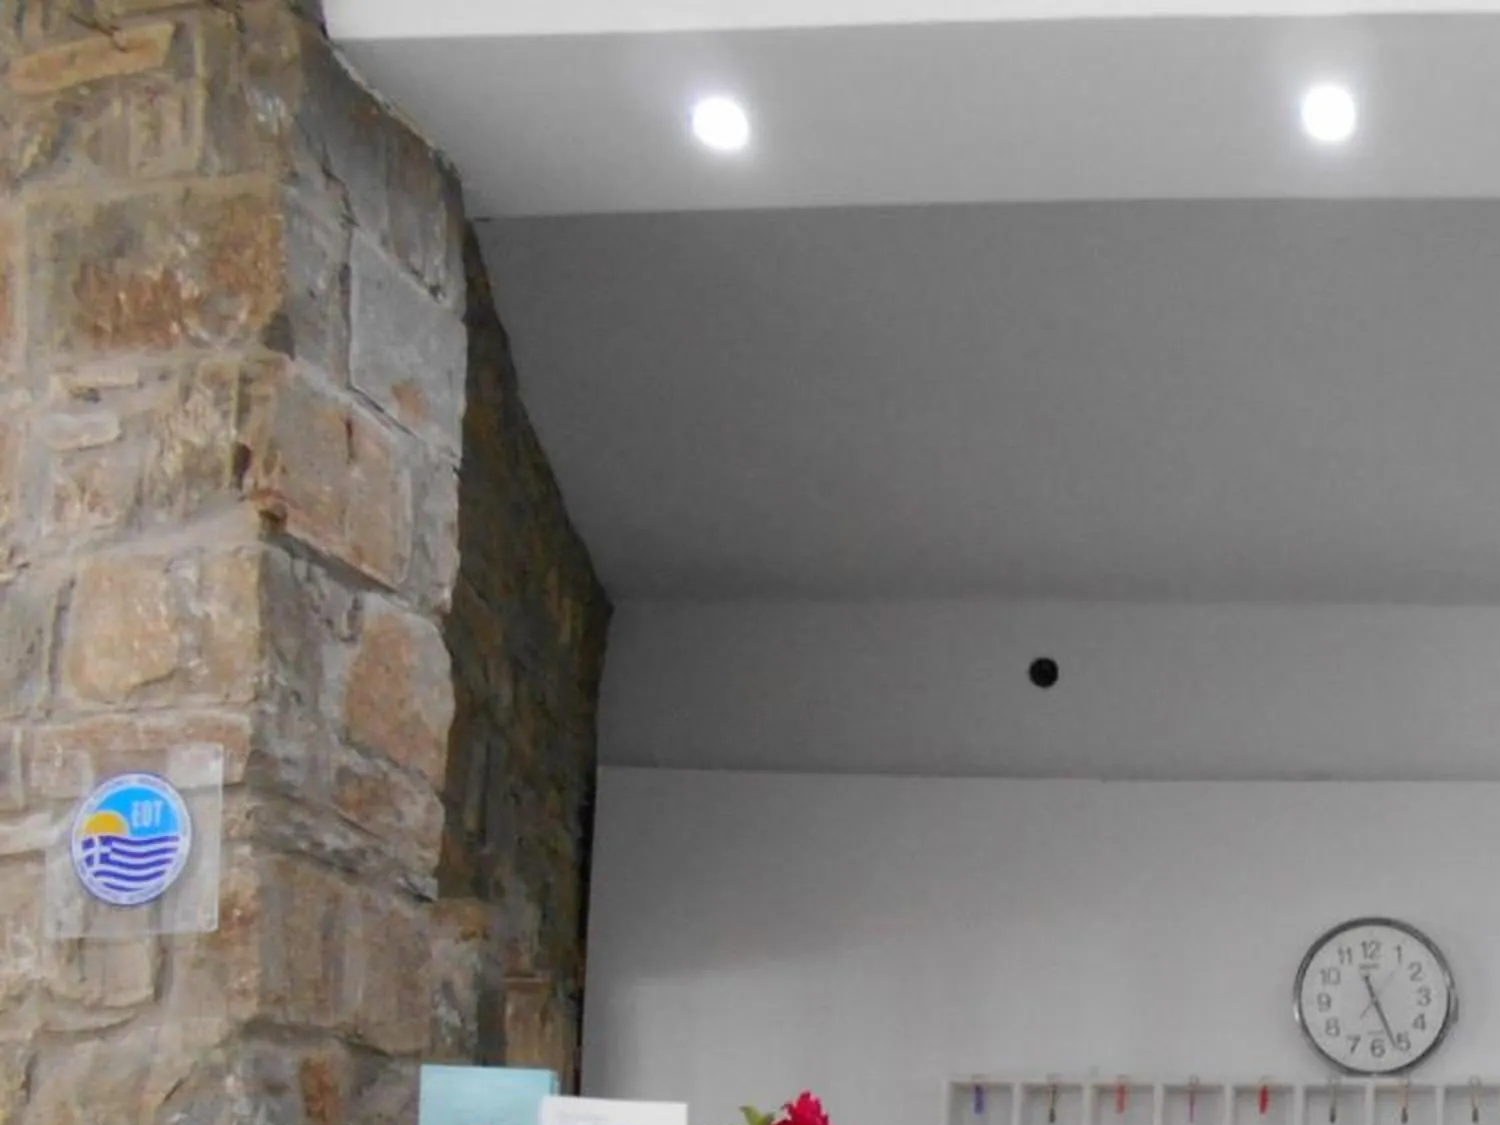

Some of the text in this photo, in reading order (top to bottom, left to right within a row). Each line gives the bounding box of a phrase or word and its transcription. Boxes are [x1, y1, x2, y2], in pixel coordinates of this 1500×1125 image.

[1338, 947, 1353, 965] 11
[1361, 940, 1381, 960] 12
[1395, 944, 1402, 964] 1
[1320, 967, 1341, 986] 10
[1408, 961, 1423, 982] 2
[1317, 992, 1332, 1013] 9
[1416, 986, 1432, 1007] 3
[1325, 1017, 1341, 1037] 8
[1412, 1013, 1426, 1031] 4
[1348, 1034, 1362, 1053] 7
[1370, 1038, 1386, 1058] 6
[1396, 1031, 1411, 1052] 5
